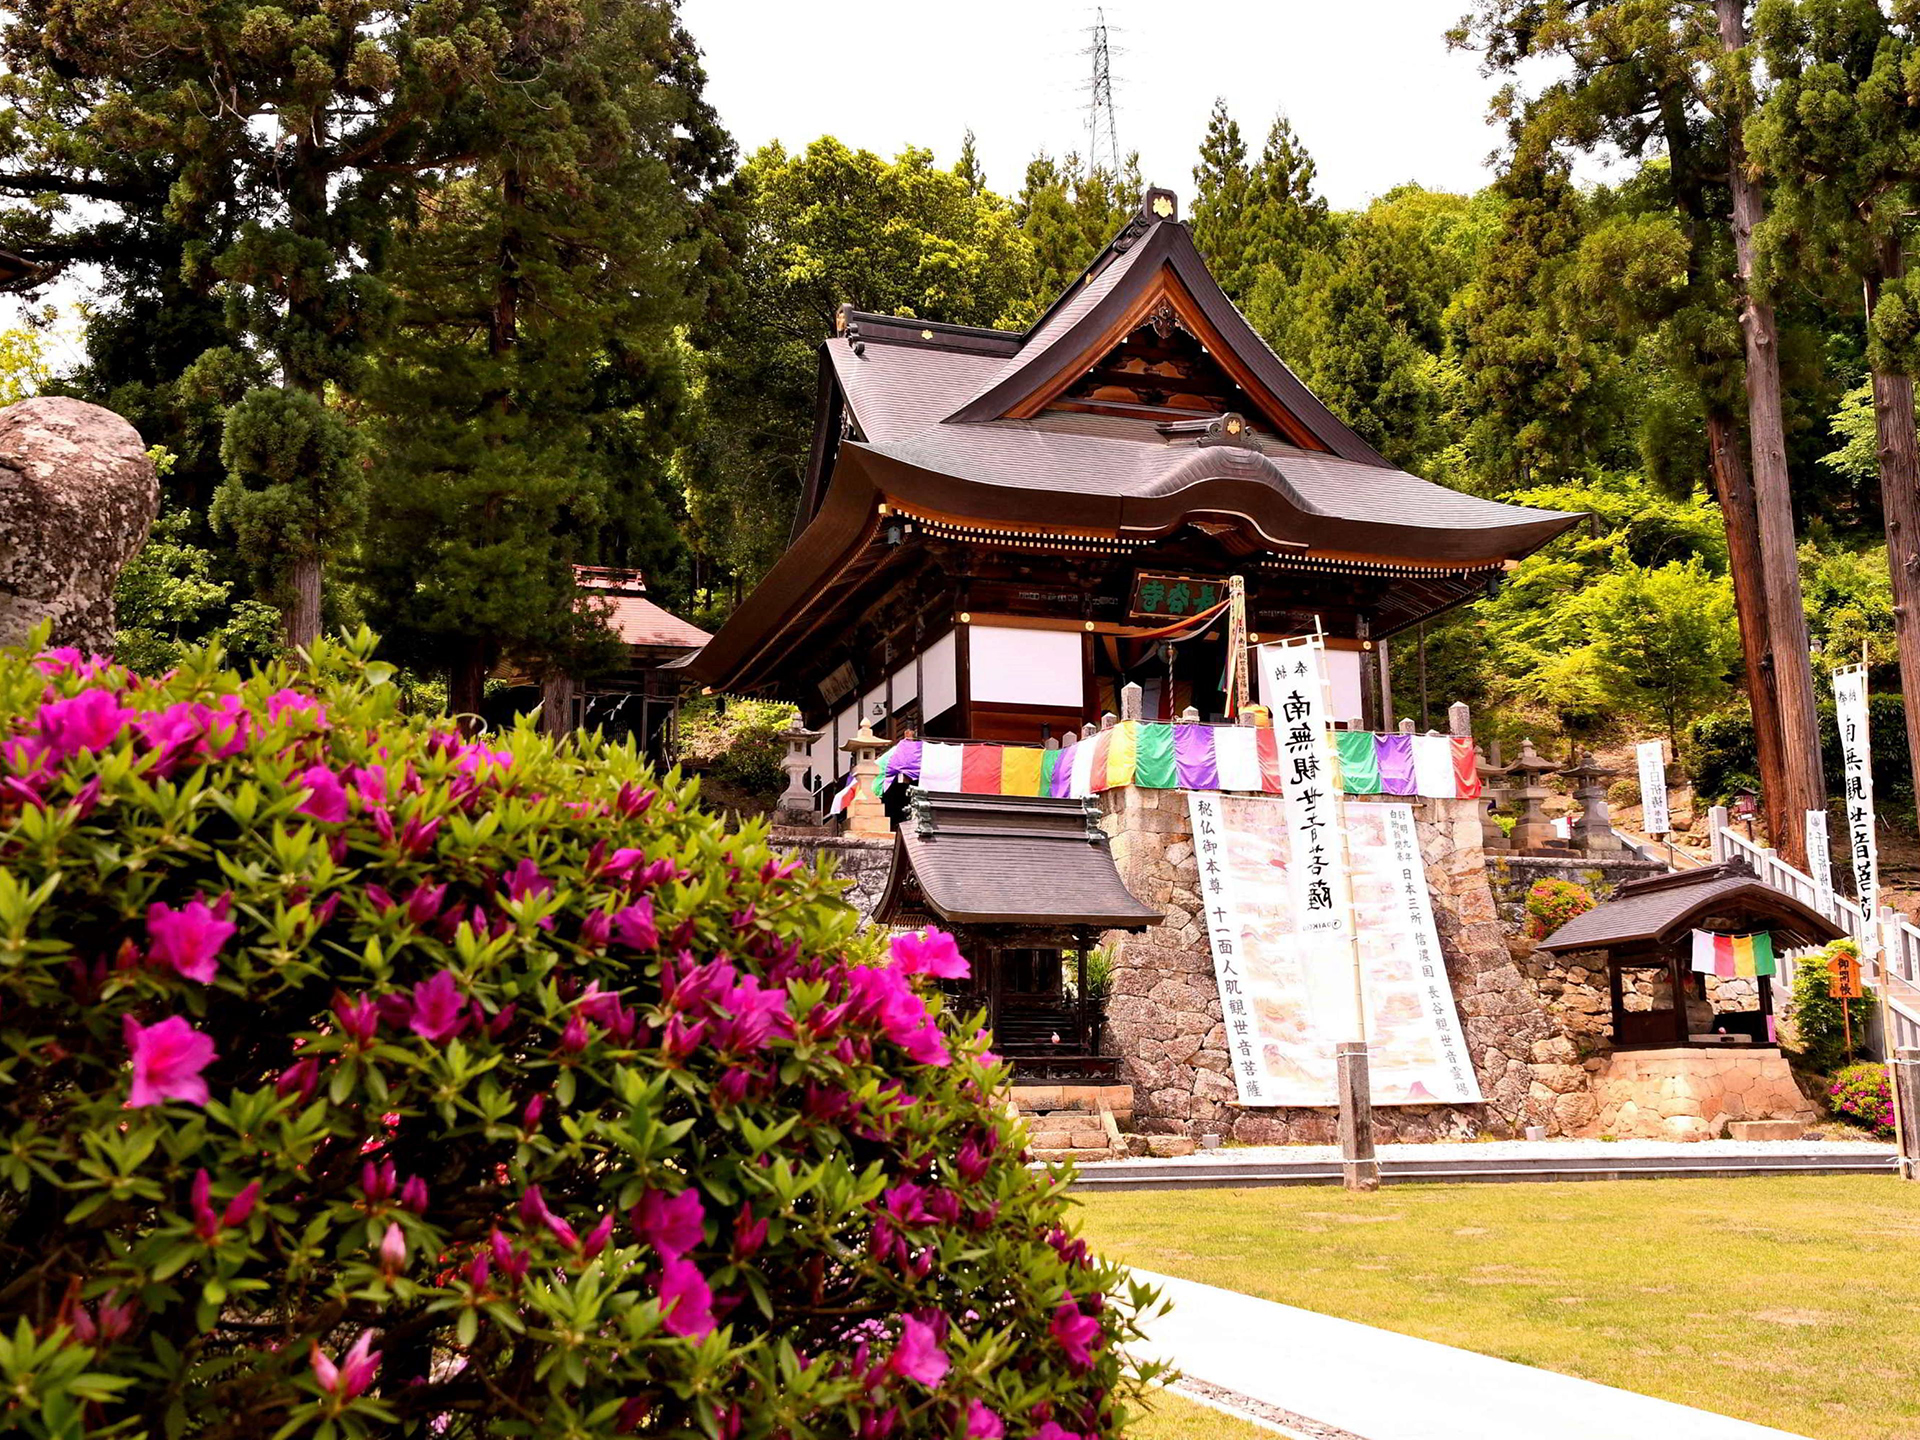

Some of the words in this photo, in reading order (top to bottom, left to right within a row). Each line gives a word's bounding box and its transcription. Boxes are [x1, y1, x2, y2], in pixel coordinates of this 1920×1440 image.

[1198, 800, 1223, 895] 秘仏御本尊
[1402, 868, 1422, 925] 日本三所
[1838, 958, 1852, 996] 御開帳
